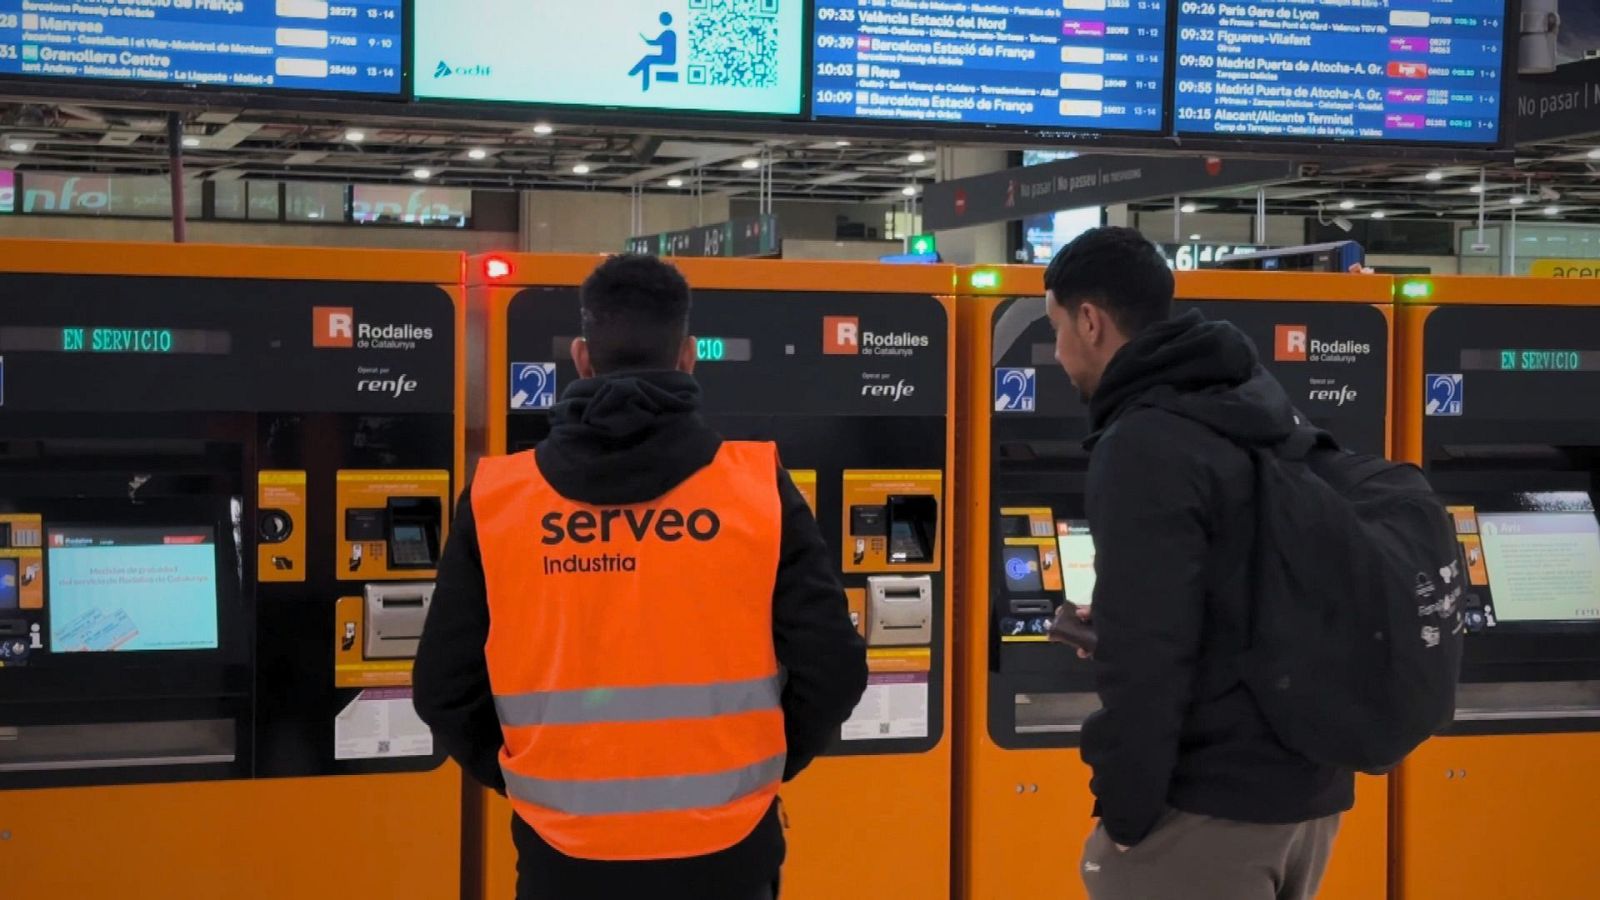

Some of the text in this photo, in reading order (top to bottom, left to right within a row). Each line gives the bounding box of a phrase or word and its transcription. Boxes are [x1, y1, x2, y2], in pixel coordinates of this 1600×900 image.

[109, 7, 123, 17] de
[818, 8, 1007, 31] 09:33 València Estació del Nord
[1181, 2, 1320, 22] 09:26 Paris Gare de Lyon
[40, 16, 104, 33] Manresa
[382, 39, 393, 49] 10
[1180, 28, 1312, 46] 09:32 Figueres-Vilafant
[40, 47, 117, 65] Granollers
[119, 52, 171, 68] Centre
[817, 35, 854, 50] 09:39
[871, 38, 932, 53] Barcelona
[933, 41, 977, 56] Estació
[978, 44, 994, 57] de
[995, 45, 1035, 64] França
[1216, 45, 1242, 54] Girona
[816, 63, 854, 77] 10:03
[870, 66, 901, 79] Reus
[1179, 55, 1214, 68] 09:50
[1216, 57, 1256, 70] Madrid
[1257, 58, 1294, 72] Puerta
[1294, 60, 1309, 73] de
[1367, 63, 1384, 75] Gr.
[174, 70, 186, 80] La
[1178, 81, 1213, 95] 09:55
[1215, 83, 1255, 96] Madrid
[1256, 85, 1293, 98] Puerta
[1293, 86, 1308, 99] de
[1366, 90, 1383, 101] Gr.
[816, 90, 853, 103] 10:09
[870, 92, 930, 108] Barcelona
[931, 95, 975, 111] Estació
[976, 98, 993, 111] de
[994, 99, 1034, 117] França
[1518, 91, 1581, 119] No pasar
[1178, 108, 1353, 126] 10:15 Alacant/Alicante Terminal
[1057, 176, 1068, 193] No
[63, 329, 172, 352] EN SERVICIO
[358, 323, 434, 340] Rodalies
[862, 331, 929, 347] Rodalies
[357, 339, 416, 351] de Catalunya
[862, 346, 914, 357] de Catalunya
[1310, 340, 1371, 354] Rodalies
[1309, 353, 1356, 364] de Catalunya
[1501, 350, 1579, 370] EN SERVICIO
[357, 373, 418, 399] renfe
[861, 378, 915, 402] renfe
[1309, 384, 1358, 407] renfe
[541, 508, 721, 545] serveo
[543, 553, 636, 575] Industria
